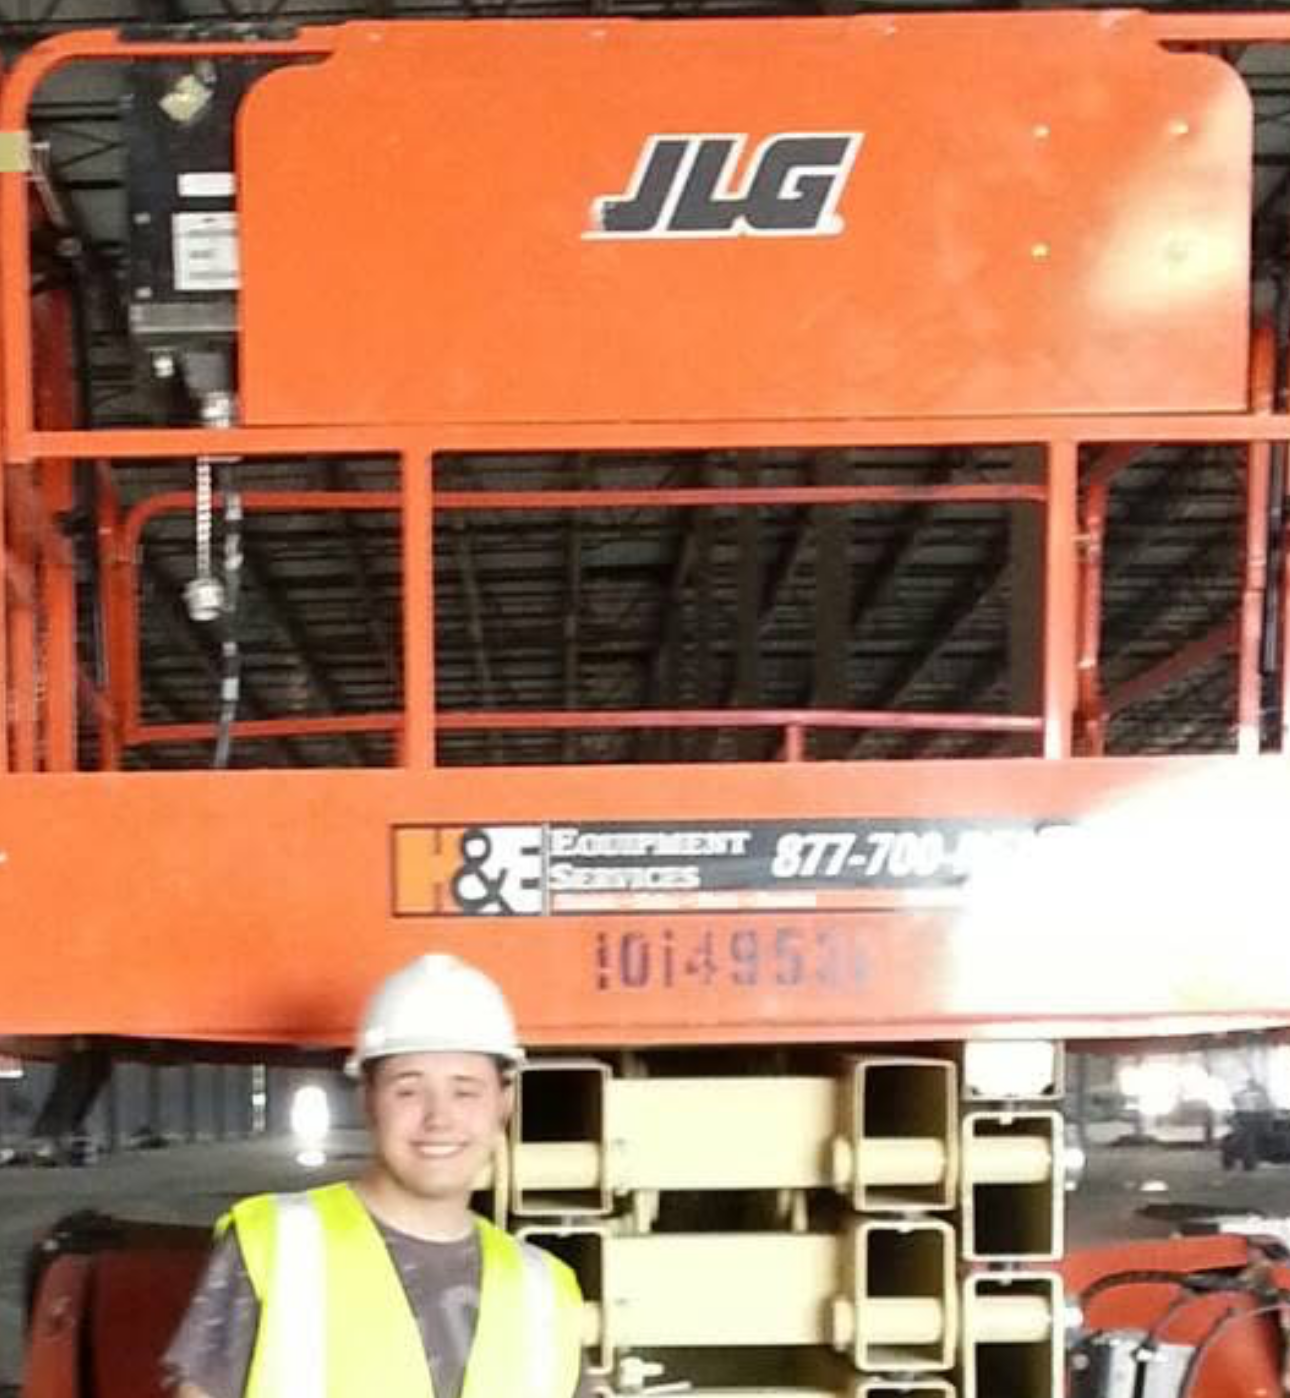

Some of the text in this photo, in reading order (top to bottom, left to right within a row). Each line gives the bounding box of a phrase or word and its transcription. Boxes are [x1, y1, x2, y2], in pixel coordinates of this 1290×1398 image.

[596, 133, 860, 234] JLG
[397, 825, 542, 915] H&E
[551, 828, 750, 856] EQUIPMENT
